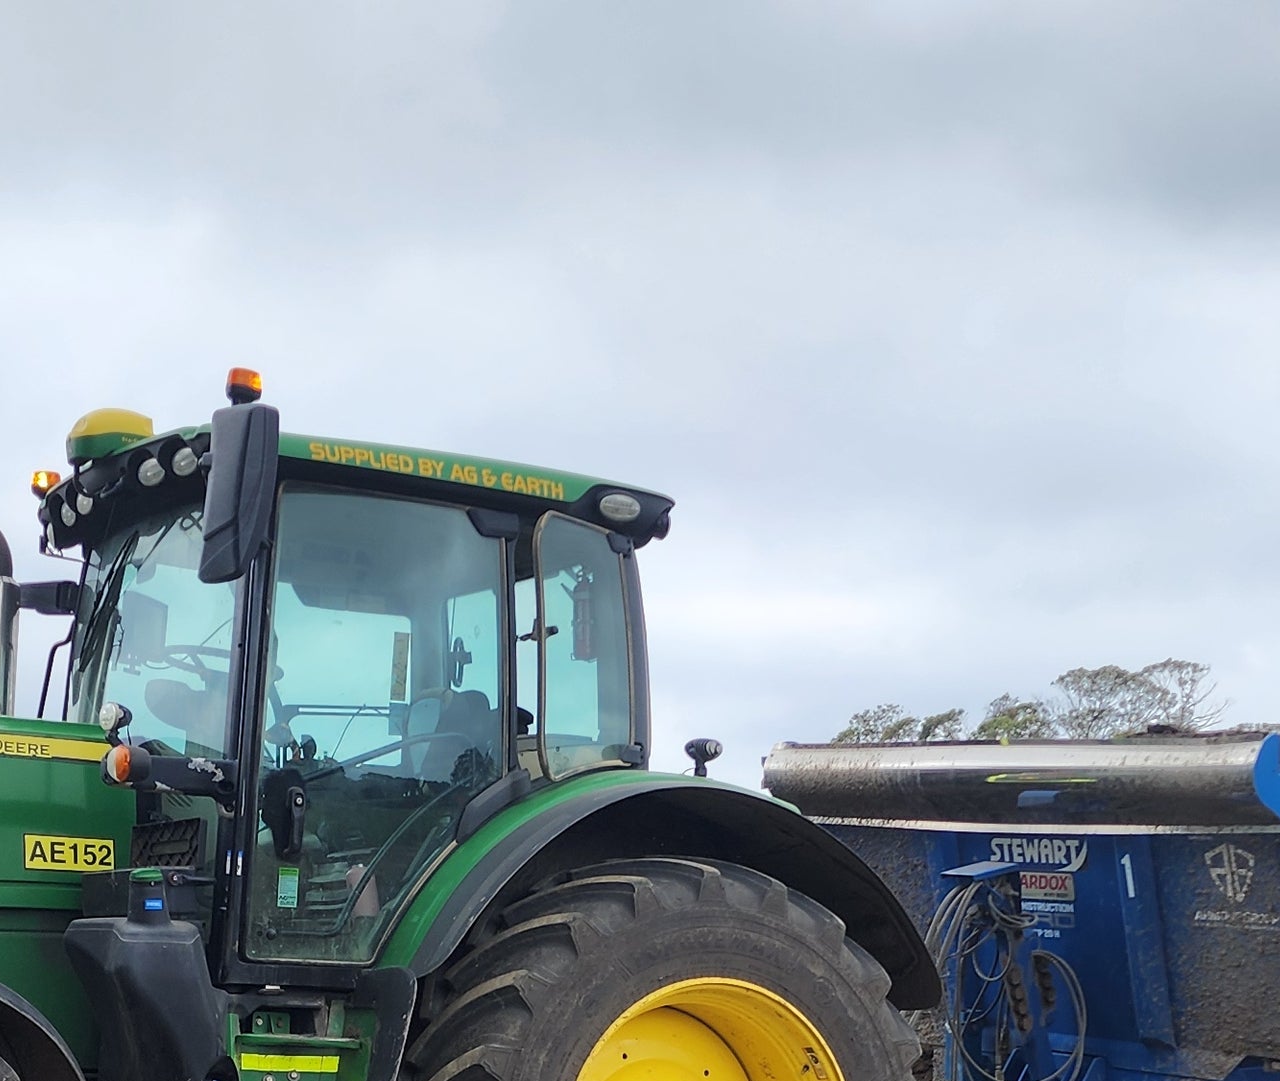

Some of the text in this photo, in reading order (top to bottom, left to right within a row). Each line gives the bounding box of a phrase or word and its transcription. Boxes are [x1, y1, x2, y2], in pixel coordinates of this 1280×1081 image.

[308, 442, 564, 501] SUPPLIED BY AG & EARTH
[29, 840, 112, 866] AE152
[990, 837, 1088, 872] STEWART
[1021, 874, 1068, 891] ARDOX
[1120, 853, 1136, 898] 1
[1021, 901, 1074, 913] NSTRUCTION
